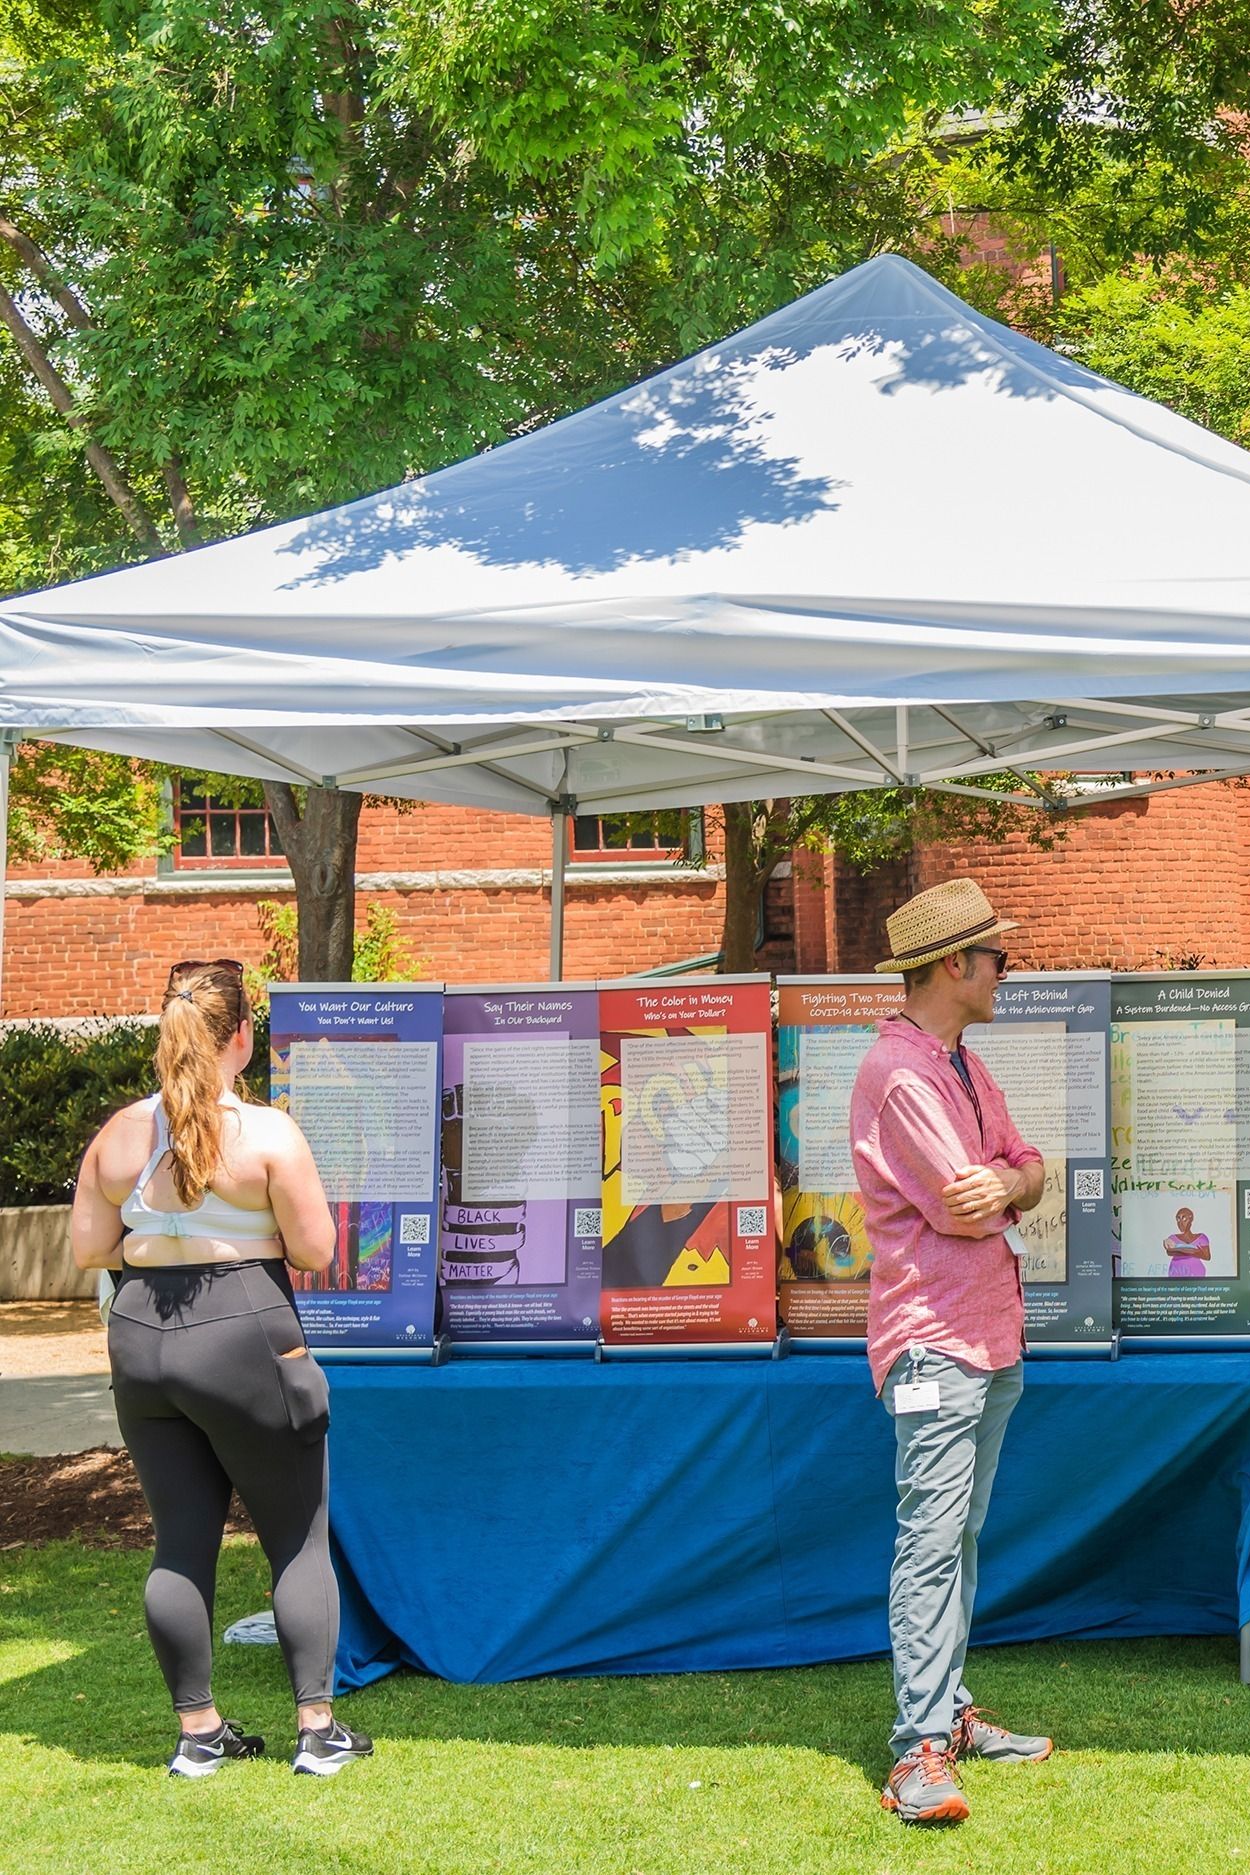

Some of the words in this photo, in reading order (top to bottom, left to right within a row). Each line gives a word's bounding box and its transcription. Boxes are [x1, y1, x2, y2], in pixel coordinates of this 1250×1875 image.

[801, 993, 847, 1007] Fighting
[849, 992, 873, 1003] Two
[875, 992, 907, 1003] Pande
[1005, 989, 1029, 1002] Left
[1031, 988, 1068, 1001] Behind
[1157, 989, 1166, 1001] A
[1169, 987, 1194, 1000] Child
[1195, 986, 1230, 999] Denied
[299, 1001, 317, 1012] You
[320, 1001, 348, 1012] Want
[350, 1001, 372, 1012] Our
[374, 1000, 414, 1012] Culture
[483, 1001, 503, 1014] Say
[505, 1001, 535, 1012] Their
[537, 1001, 573, 1011] Names
[636, 996, 659, 1008] The
[661, 995, 686, 1007] Color
[689, 995, 698, 1005] in
[701, 994, 734, 1006] Money
[644, 1011, 667, 1021] Who's
[668, 1012, 677, 1020] on
[679, 1010, 696, 1020] Your
[698, 1008, 727, 1018] Dollar?
[809, 1007, 852, 1017] COVID-19
[861, 1007, 900, 1016] RACISM
[1008, 1006, 1023, 1014] the
[1024, 1004, 1075, 1014] Achievement
[1077, 1003, 1095, 1014] Gap
[1116, 1005, 1123, 1015] A
[1124, 1005, 1153, 1015] System
[1211, 1002, 1237, 1012] Access
[317, 1016, 332, 1025] You
[333, 1016, 356, 1025] Don't
[357, 1016, 379, 1025] Want
[380, 1016, 394, 1025] Us!
[494, 1016, 506, 1025] In
[526, 1014, 562, 1025] Backyard
[457, 1208, 501, 1224] BLACK
[1018, 1211, 1067, 1240] ustice
[454, 1235, 496, 1250] LIVES
[449, 1264, 493, 1277] MATTER
